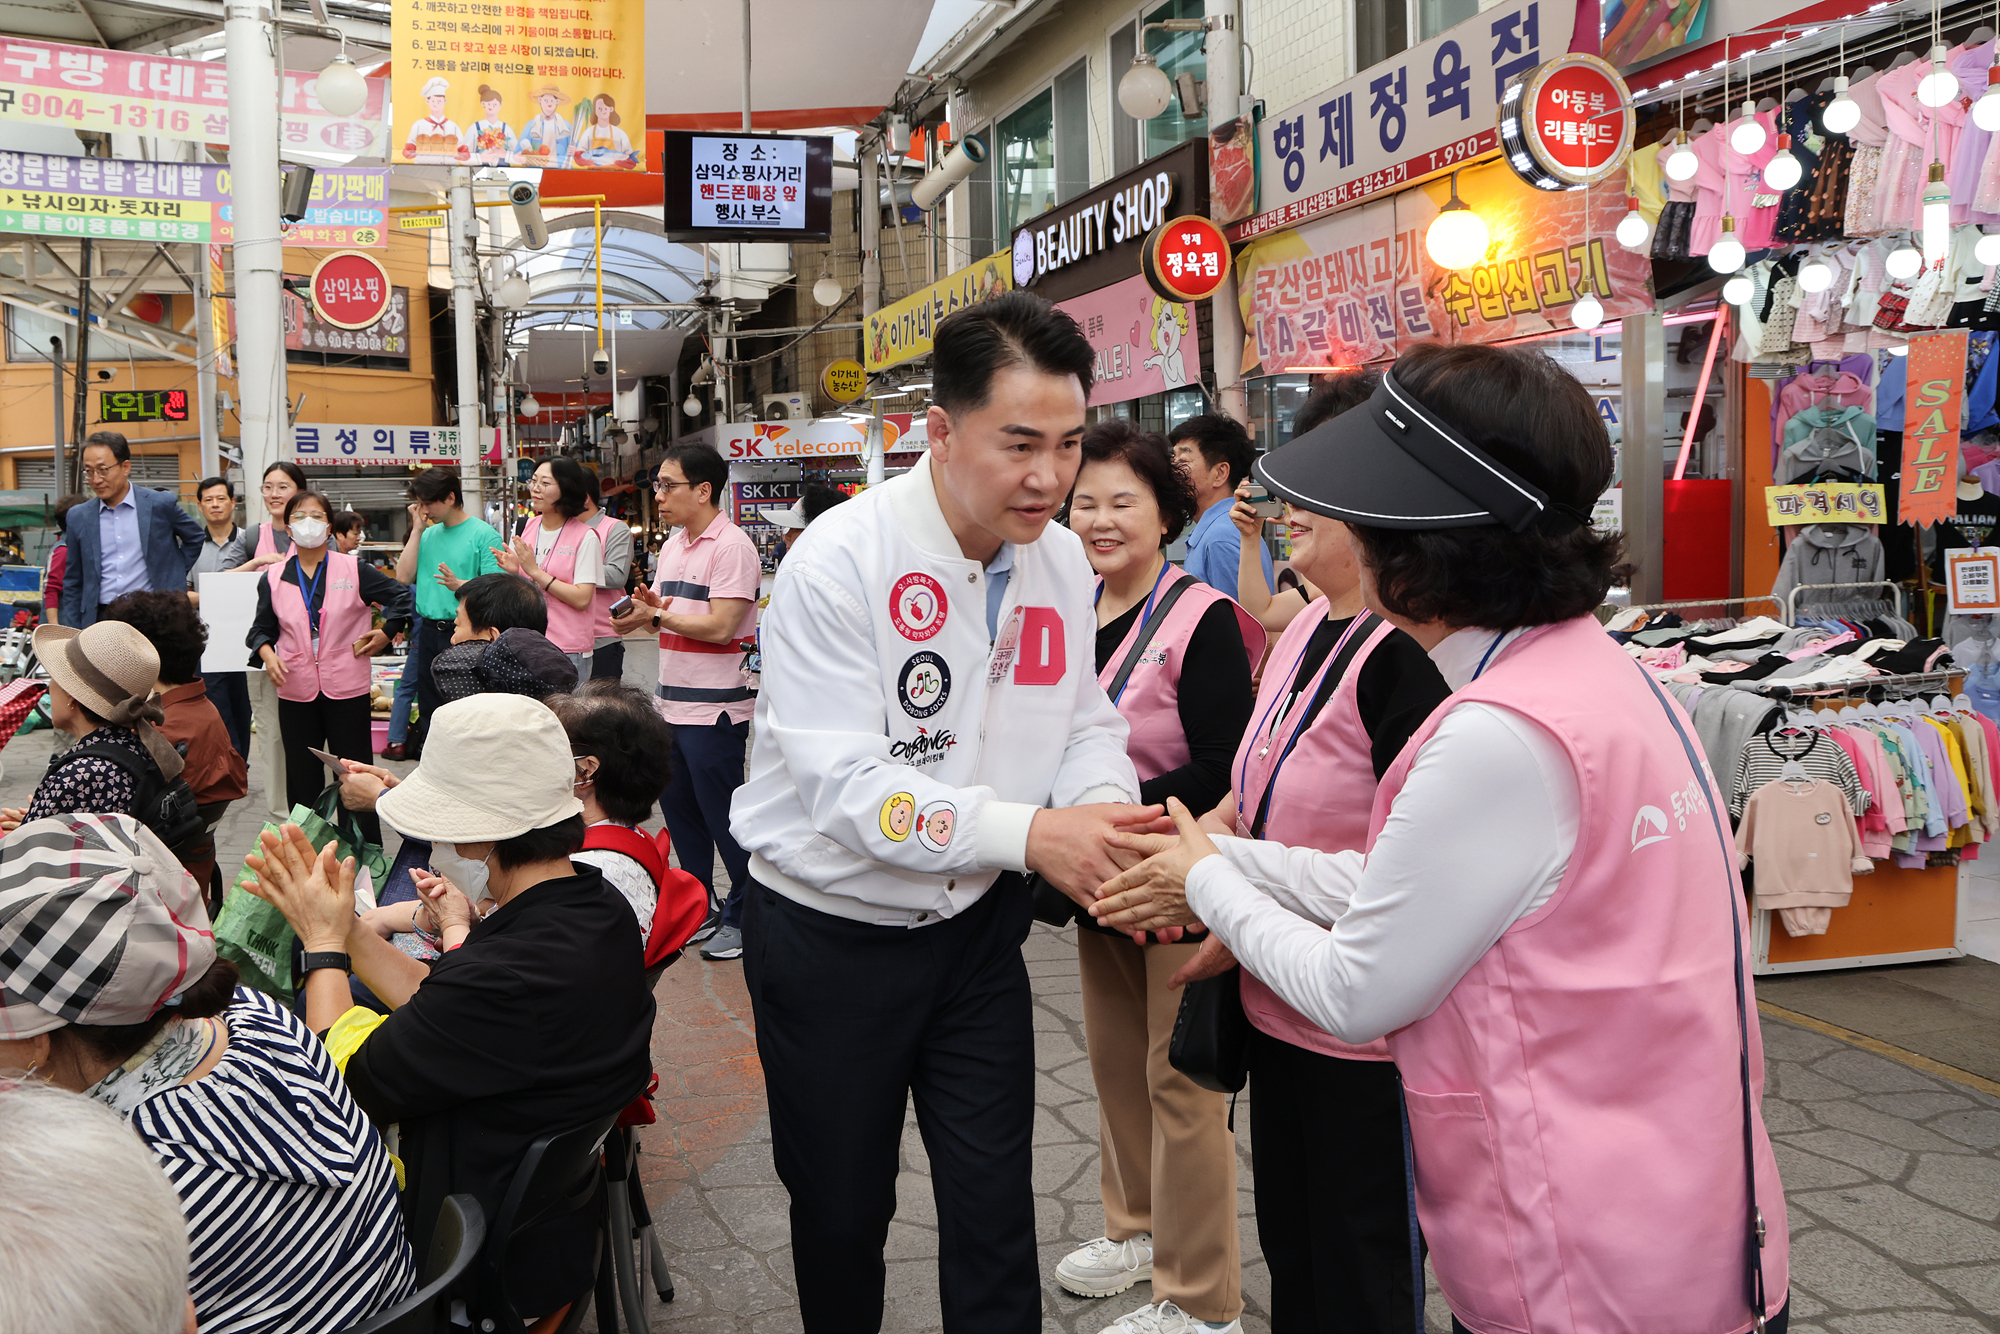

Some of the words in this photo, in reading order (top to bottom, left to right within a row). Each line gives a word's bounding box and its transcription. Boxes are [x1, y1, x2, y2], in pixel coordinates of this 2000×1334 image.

[412, 2, 423, 12] 4.
[426, 1, 468, 14] 깨끗하고
[471, 3, 502, 17] 안전한
[505, 5, 535, 19] 환경을
[538, 7, 593, 21] 책임집니다.
[412, 20, 423, 31] 5.
[426, 21, 458, 34] 고객의
[460, 23, 502, 36] 목소리에
[505, 25, 515, 37] 귀
[518, 25, 559, 39] 기울이며
[561, 28, 616, 41] 소통합니다.
[412, 40, 423, 50] 6.
[426, 40, 447, 52] 믿고
[450, 42, 460, 53] 더
[463, 42, 484, 55] 찾고
[487, 43, 508, 56] 싶은
[510, 44, 541, 58] 시장이
[544, 45, 599, 59] 되겠습니다.
[412, 59, 423, 70] 7.
[425, 59, 457, 72] 전통을
[460, 60, 491, 74] 살리며
[494, 62, 535, 76] 혁신으로
[537, 64, 568, 78] 발전을
[571, 65, 625, 80] 이어갑니다.
[1551, 88, 1608, 114] 아동복
[21, 92, 190, 132] 904-1316
[1544, 120, 1615, 146] 리틀랜드
[722, 143, 738, 162] 장
[694, 164, 802, 183] 삼익쇼핑사거리
[700, 183, 777, 202] 핸드폰매장
[783, 185, 797, 202] 앞
[715, 203, 745, 220] 행사
[751, 204, 781, 221] 부스
[1036, 199, 1109, 275] BEAUTY
[1112, 171, 1173, 244] SHOP
[356, 231, 376, 243] 2층
[1181, 233, 1201, 246] 형제
[1166, 251, 1219, 277] 정육점
[1256, 228, 1419, 307] 국산암돼지고기
[322, 277, 379, 304] 삼익쇼핑
[1442, 237, 1613, 327] 수입쇠고기
[385, 336, 399, 352] 2F
[830, 370, 860, 380] 이가네
[832, 380, 858, 393] 농수산
[1909, 378, 1952, 495] SALE
[729, 438, 765, 458] SK
[774, 438, 862, 456] telecom
[742, 484, 765, 499] SK
[770, 483, 791, 498] KT
[1774, 489, 1881, 517] 파격세일
[911, 654, 934, 667] SEOUL
[902, 699, 928, 718] DOBONG
[929, 691, 948, 714] SOCKS
[247, 928, 280, 959] THINK
